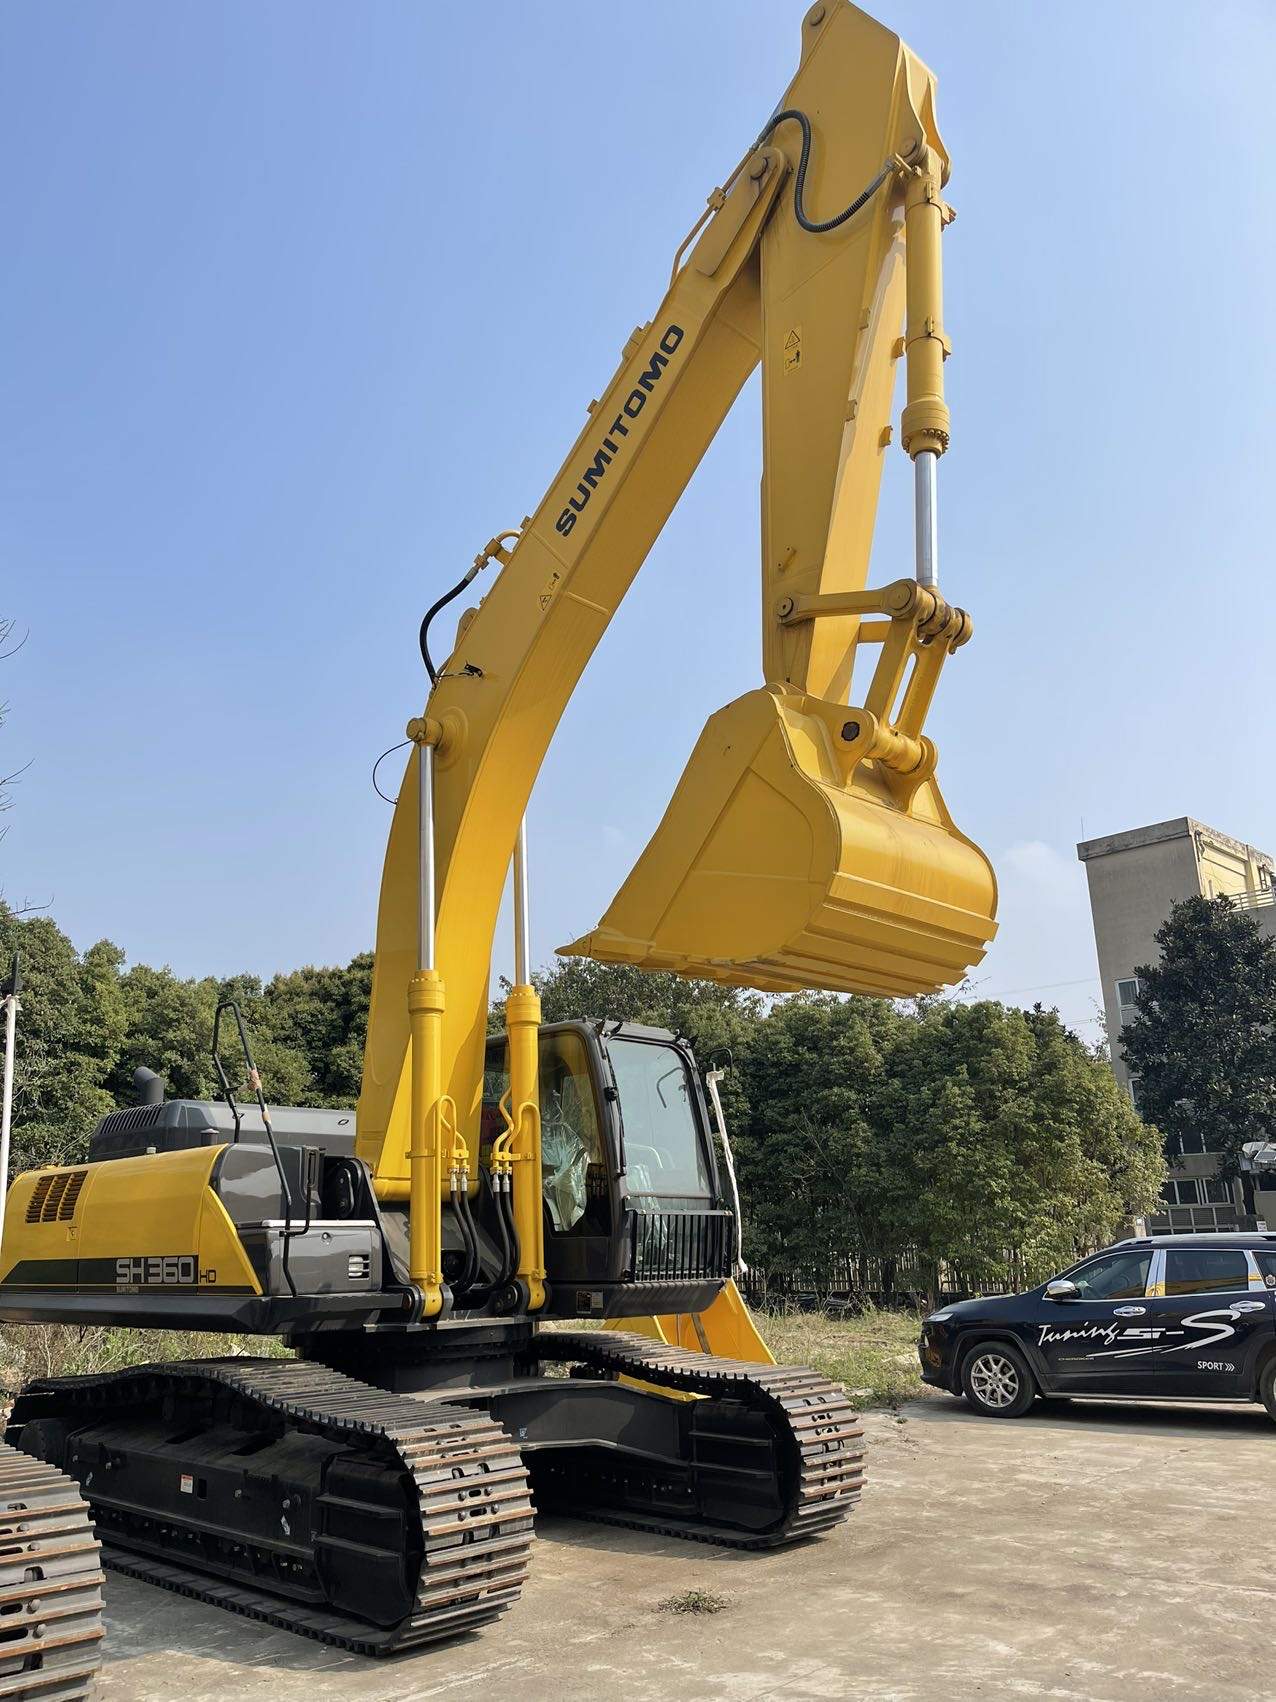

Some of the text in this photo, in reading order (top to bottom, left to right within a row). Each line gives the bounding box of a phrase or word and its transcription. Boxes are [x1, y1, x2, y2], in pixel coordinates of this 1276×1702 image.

[555, 324, 684, 537] SUMITOMO
[199, 1269, 217, 1283] HD
[1038, 1321, 1118, 1346] Tuning
[1197, 1361, 1224, 1371] SPORT
